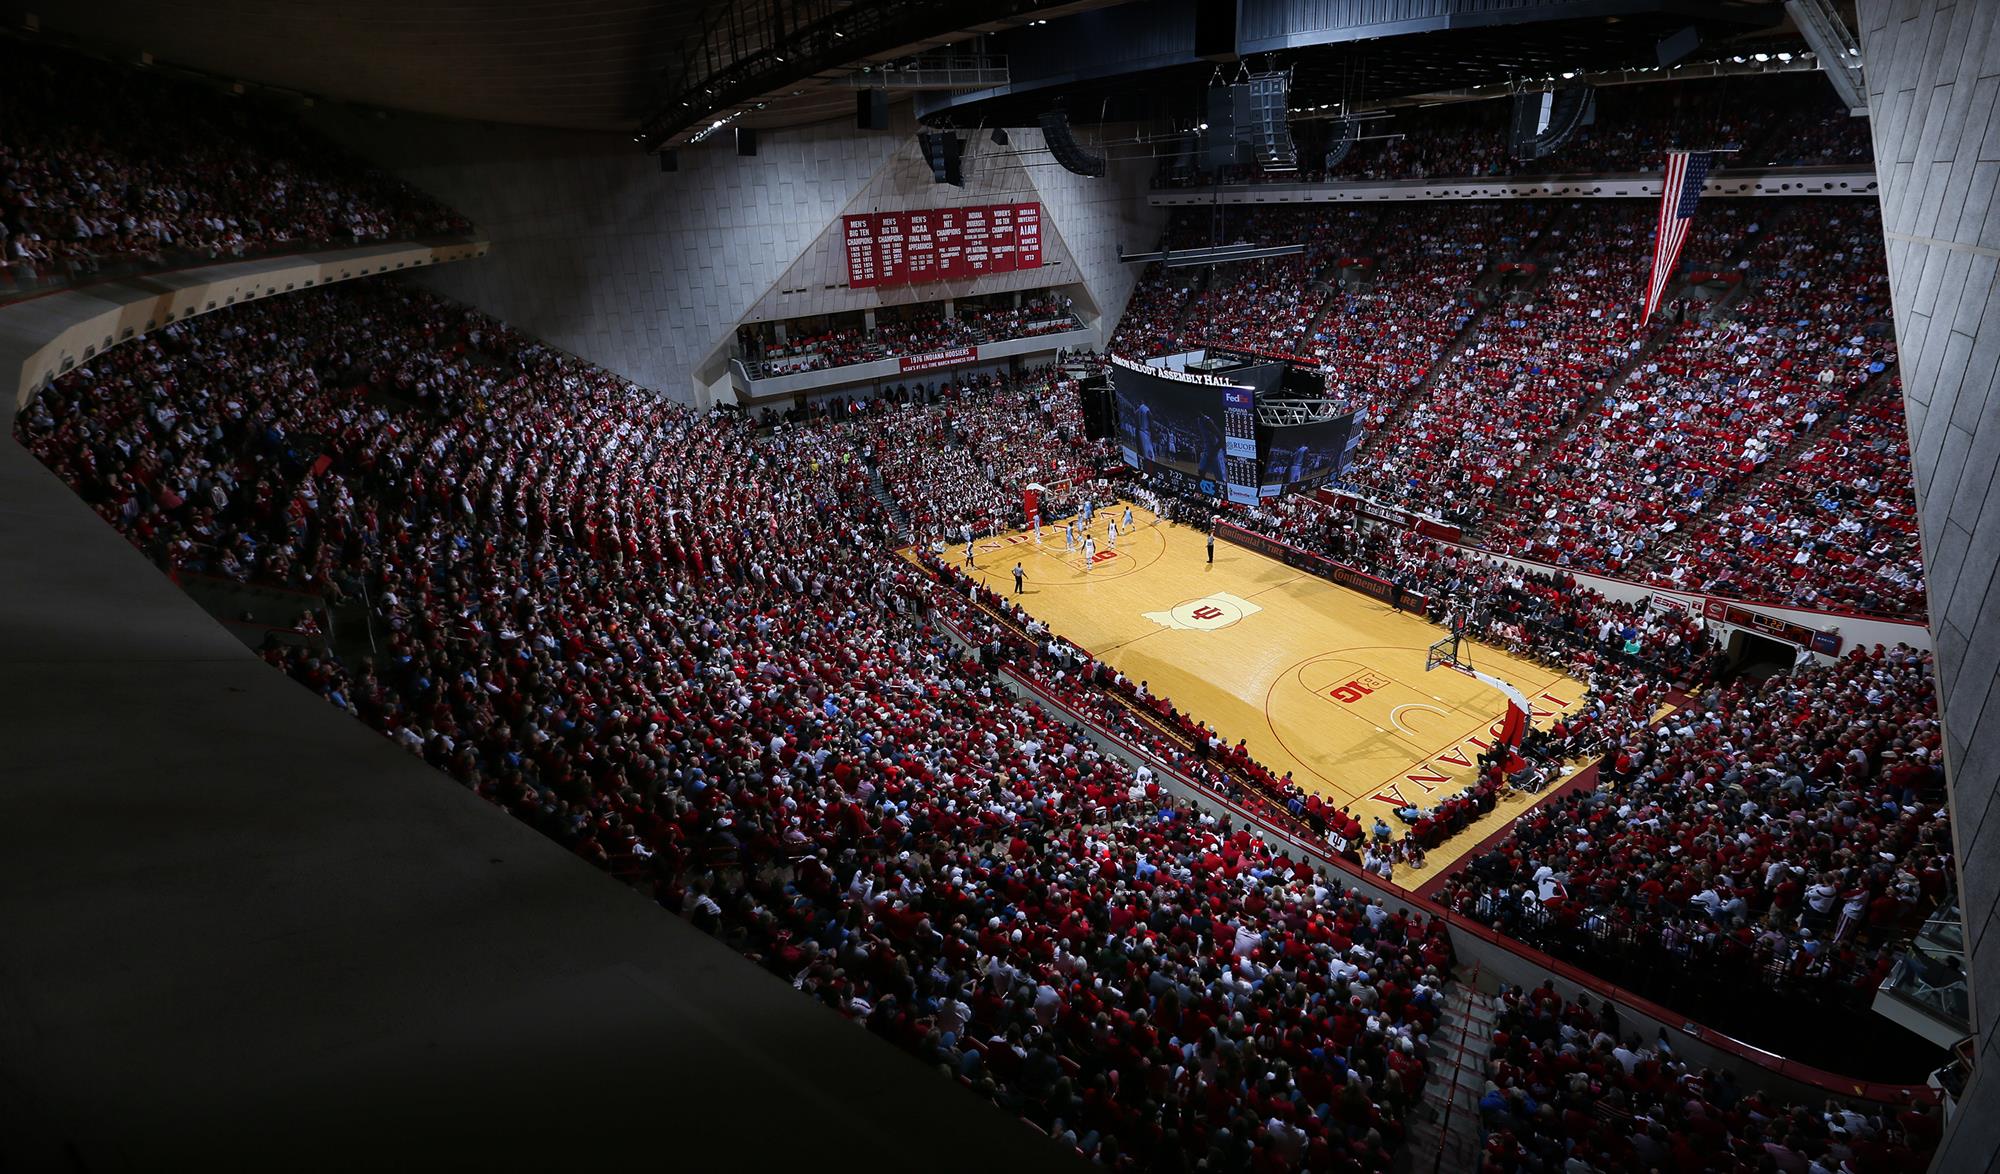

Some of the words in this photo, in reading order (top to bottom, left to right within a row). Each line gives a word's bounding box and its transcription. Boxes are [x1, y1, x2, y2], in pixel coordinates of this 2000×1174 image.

[937, 228, 961, 236] CHAMPIONS
[1020, 225, 1037, 235] AIAW
[847, 237, 873, 246] CHAMPIONS
[878, 235, 903, 243] CHAMPIONS
[910, 356, 922, 364] 1976
[924, 353, 944, 361] INDIANA
[945, 348, 969, 359] HOOSIERS
[1111, 354, 1130, 369] SIMON
[1131, 361, 1157, 376] SKJODT
[1158, 368, 1202, 384] ASSEMBLY
[1203, 375, 1232, 386] HALL
[1169, 470, 1182, 480] 7:22
[1365, 504, 1385, 516] Credit
[1386, 511, 1406, 522] Union
[1219, 525, 1260, 547] Continental
[1266, 544, 1284, 556] TIRE
[1334, 568, 1385, 595] Continental
[1192, 606, 1224, 619] IU
